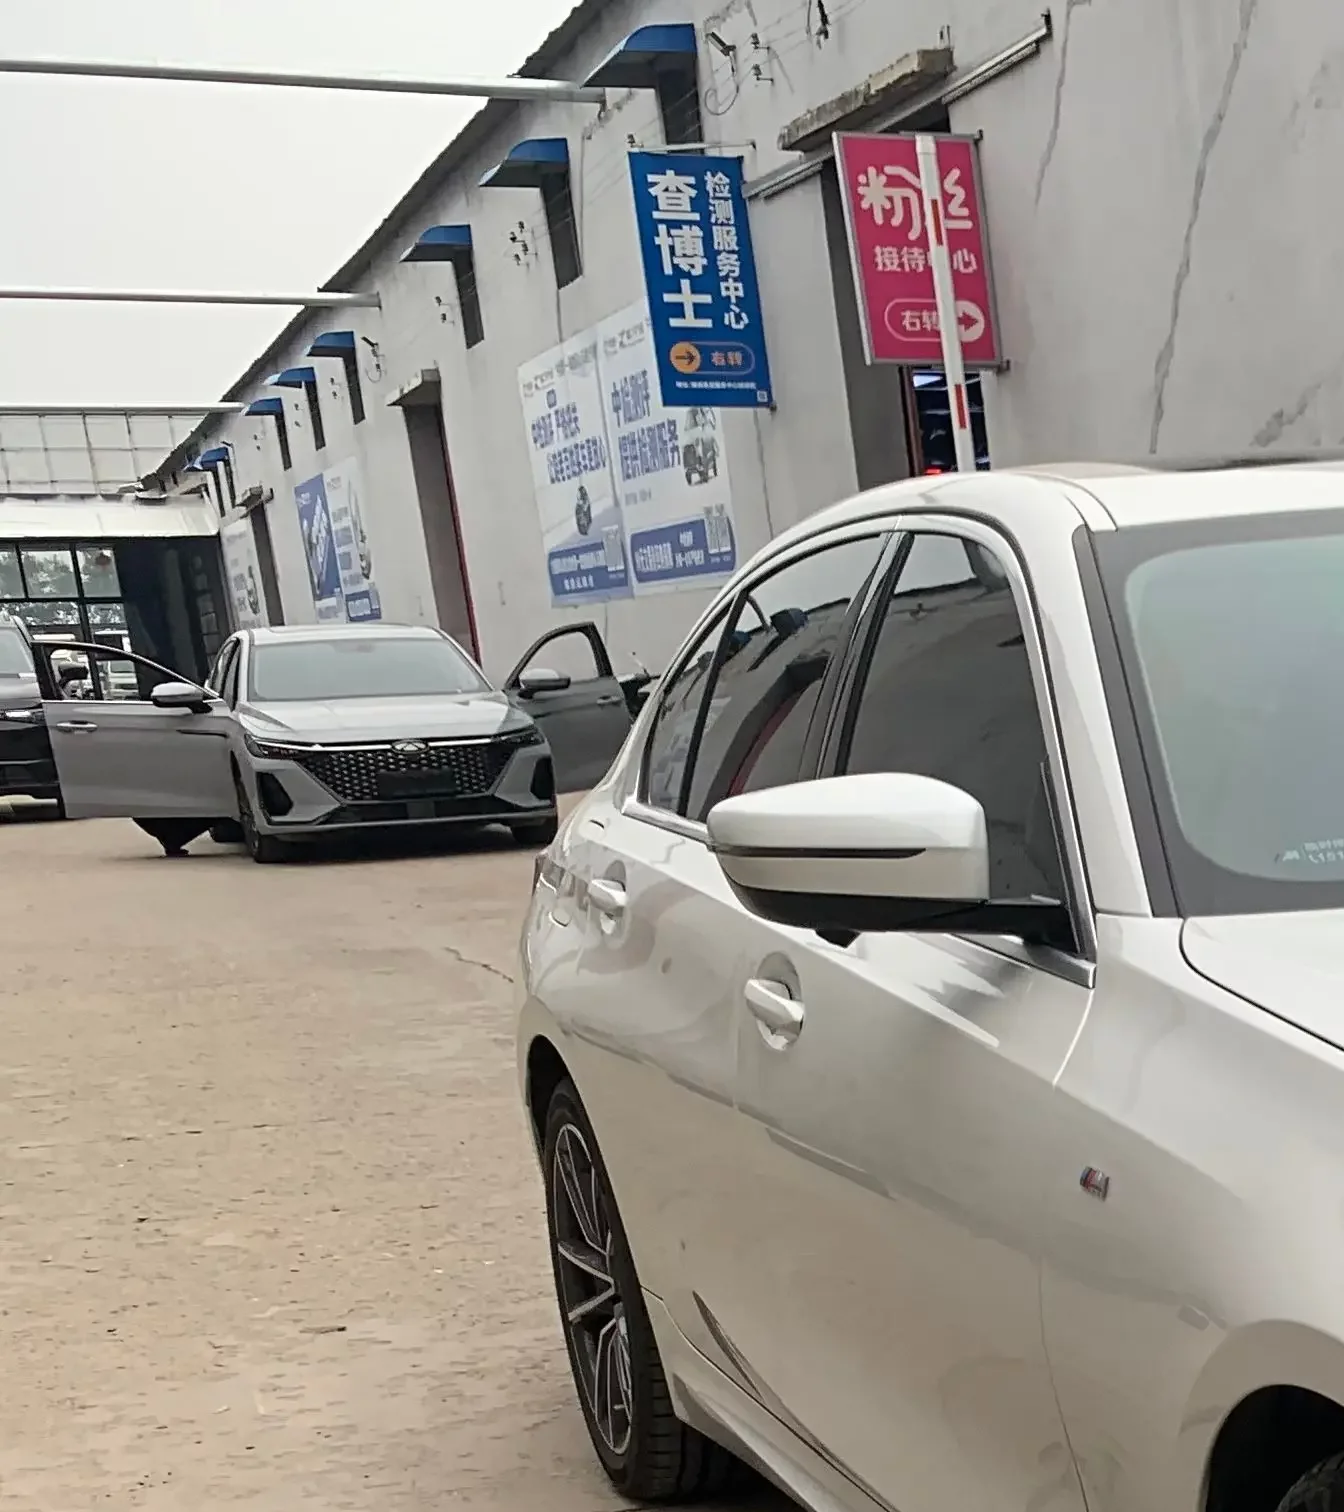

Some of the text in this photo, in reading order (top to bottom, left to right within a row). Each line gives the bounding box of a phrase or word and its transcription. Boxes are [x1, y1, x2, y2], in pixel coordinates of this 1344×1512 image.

[646, 169, 713, 329] 查博士
[703, 170, 750, 330] 检测服务中心
[874, 245, 978, 273] 接待心
